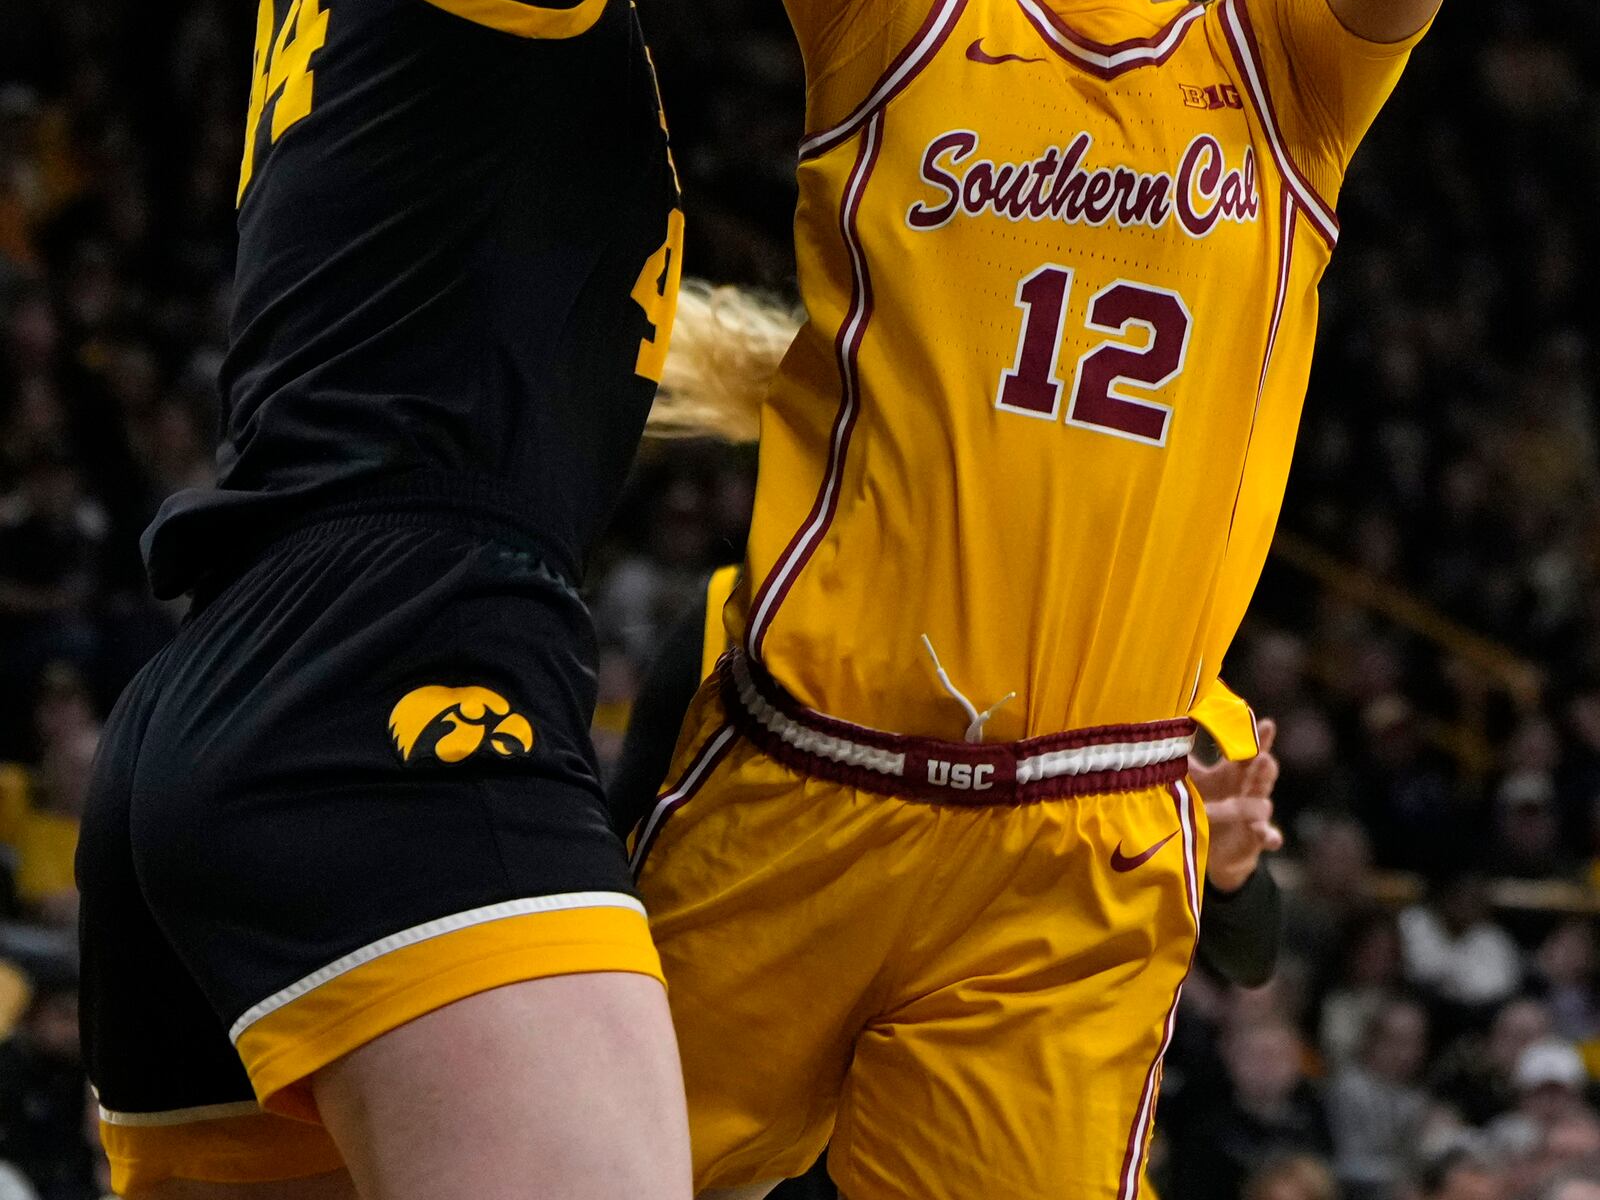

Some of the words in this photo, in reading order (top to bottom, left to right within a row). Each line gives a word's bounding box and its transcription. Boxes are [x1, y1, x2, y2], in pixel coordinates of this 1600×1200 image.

[904, 129, 1174, 231] Southern
[1174, 133, 1258, 239] Cal
[995, 262, 1193, 447] 12
[927, 759, 995, 790] USC
